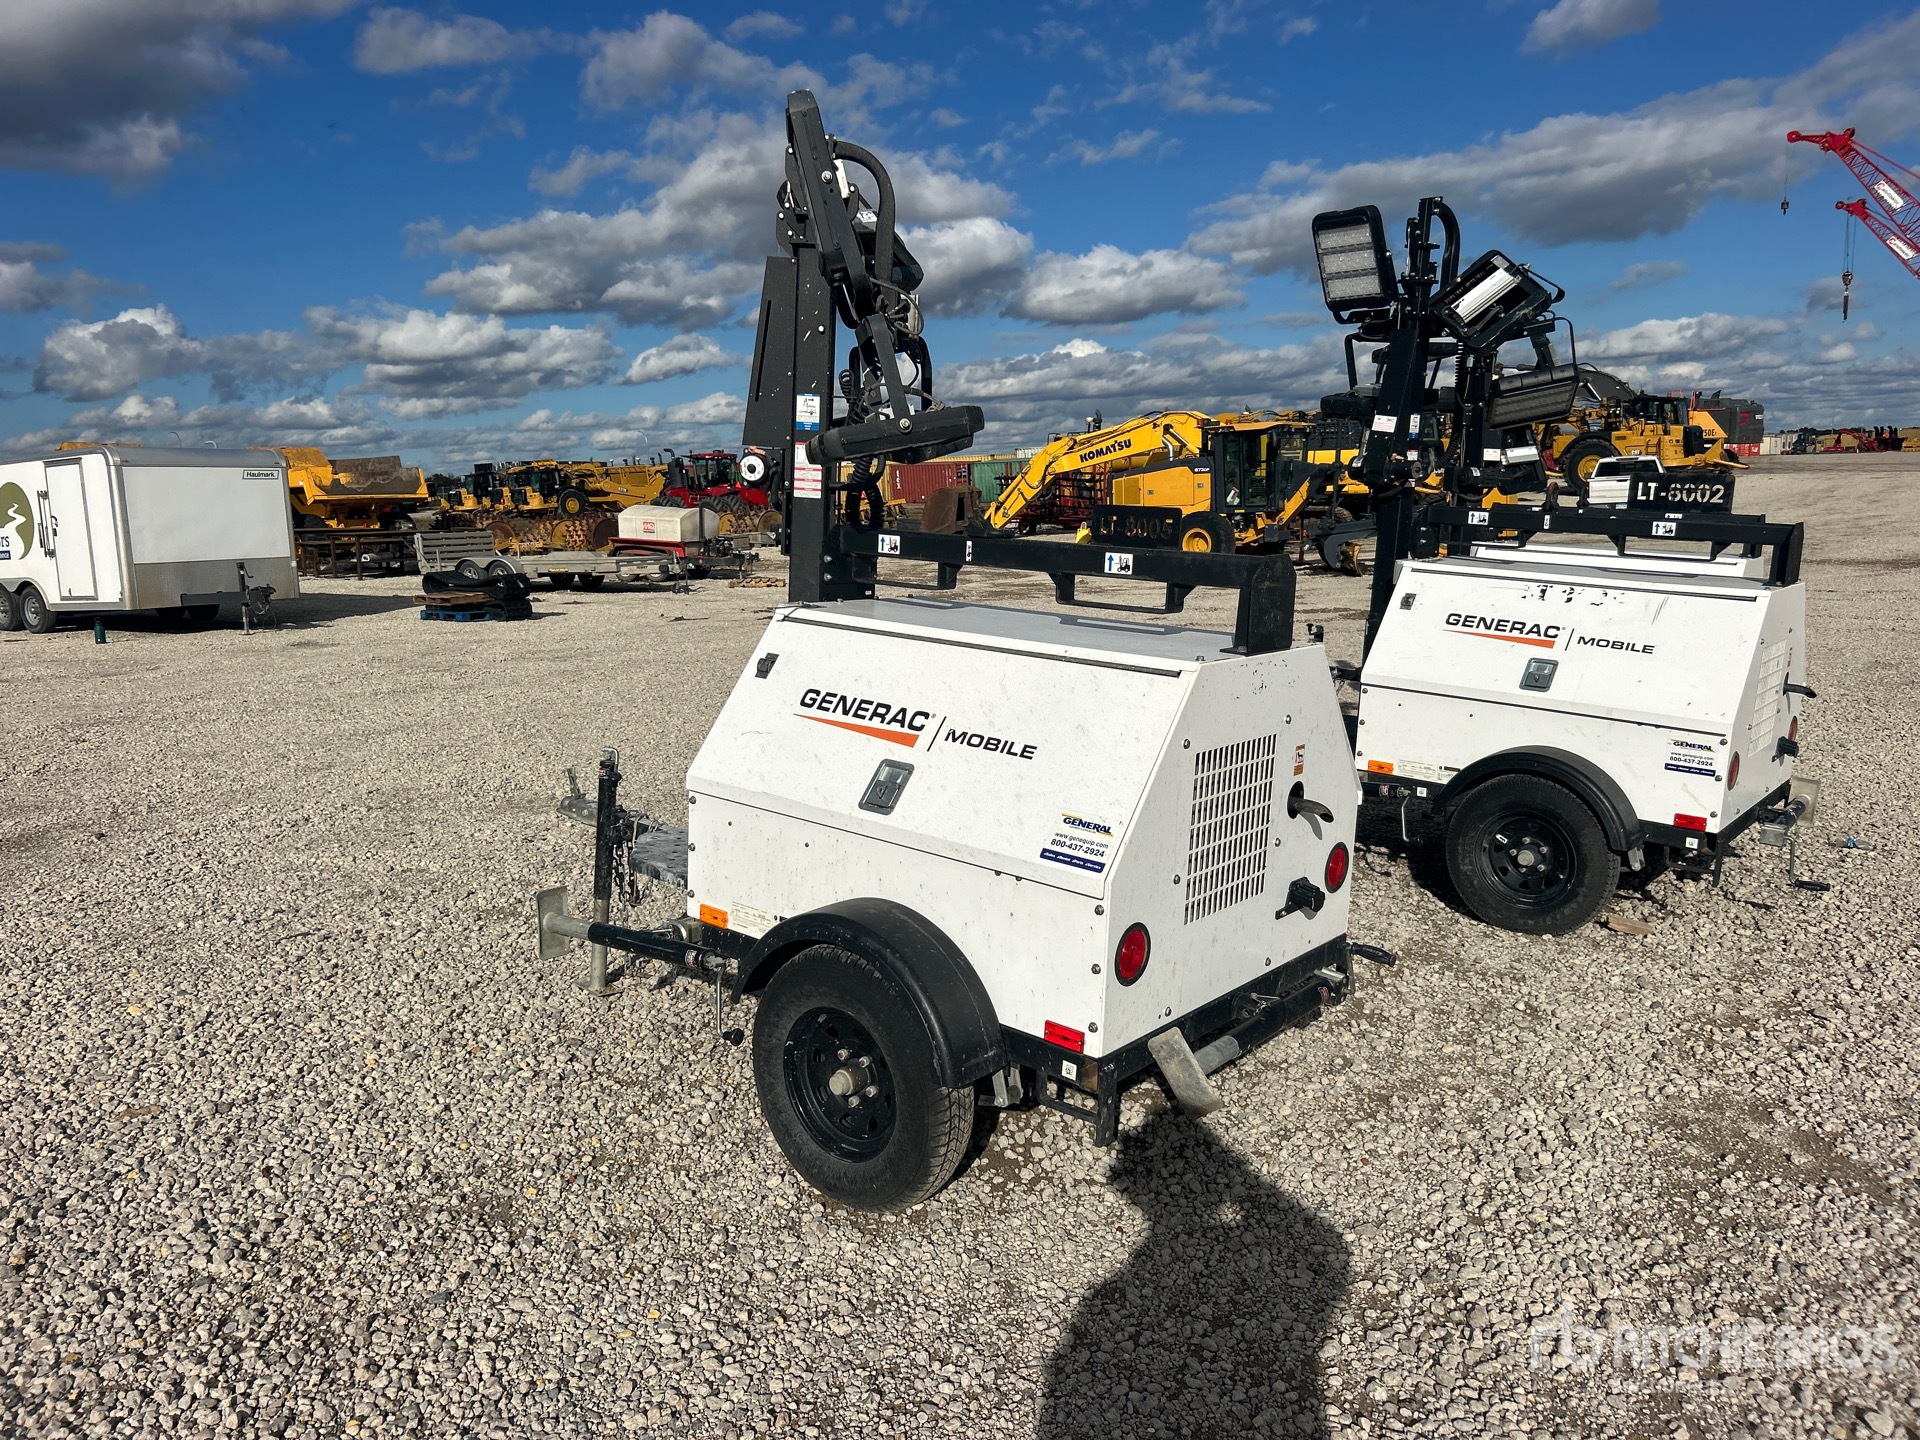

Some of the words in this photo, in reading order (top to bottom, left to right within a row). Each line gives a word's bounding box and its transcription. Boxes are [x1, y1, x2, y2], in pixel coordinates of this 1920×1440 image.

[1080, 438, 1132, 463] KOMATSU
[1636, 482, 1725, 504] LT-8002
[1445, 613, 1561, 639] GENERAC
[1576, 636, 1655, 655] MOBILE
[799, 687, 931, 732] GENERAC
[944, 728, 1038, 760] MOBILE
[1673, 741, 1712, 751] GENERAL
[1670, 756, 1713, 767] 800-437-2924
[1062, 817, 1112, 834] GENERAL
[1050, 838, 1106, 858] 800-437-2924
